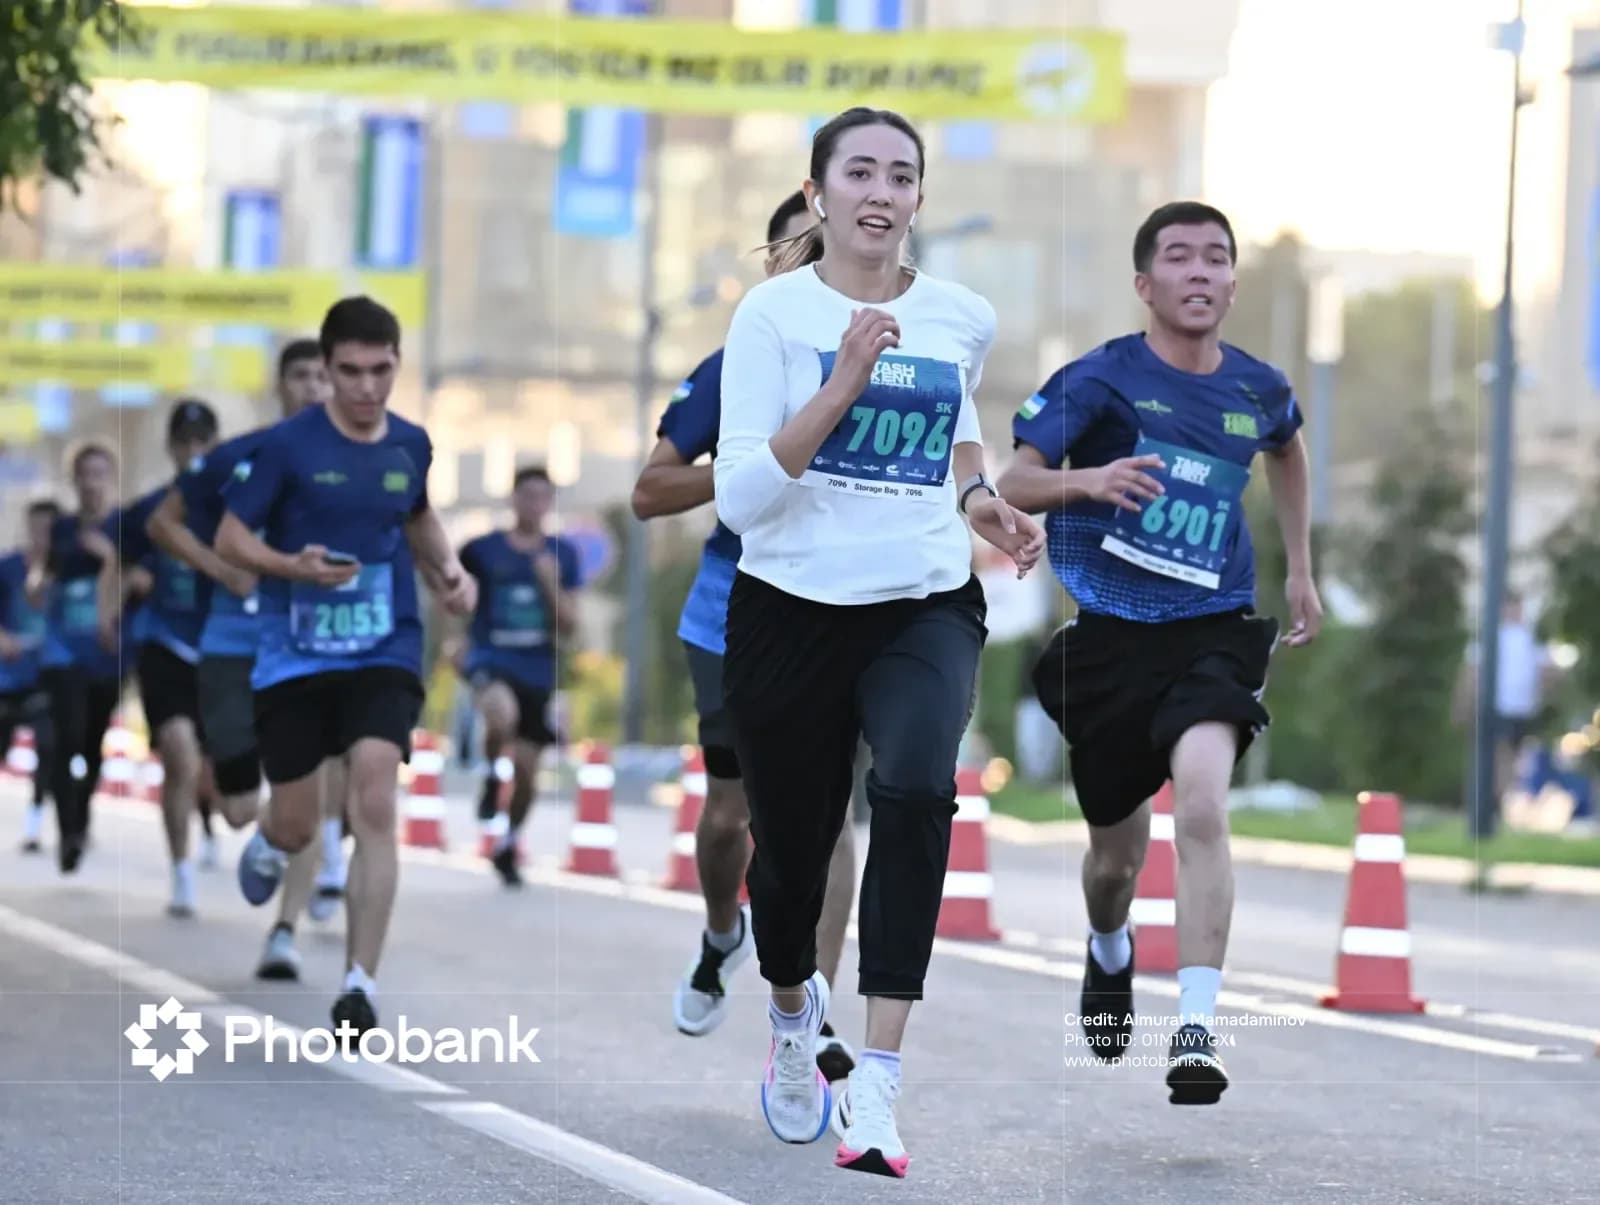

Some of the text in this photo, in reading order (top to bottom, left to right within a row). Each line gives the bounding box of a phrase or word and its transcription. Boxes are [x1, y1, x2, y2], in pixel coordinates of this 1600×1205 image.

[936, 402, 952, 414] 5K
[847, 406, 951, 461] 7096
[828, 478, 923, 497] 7096 Storage Bag 7096
[1141, 495, 1227, 552] 6901
[315, 602, 391, 638] 2053
